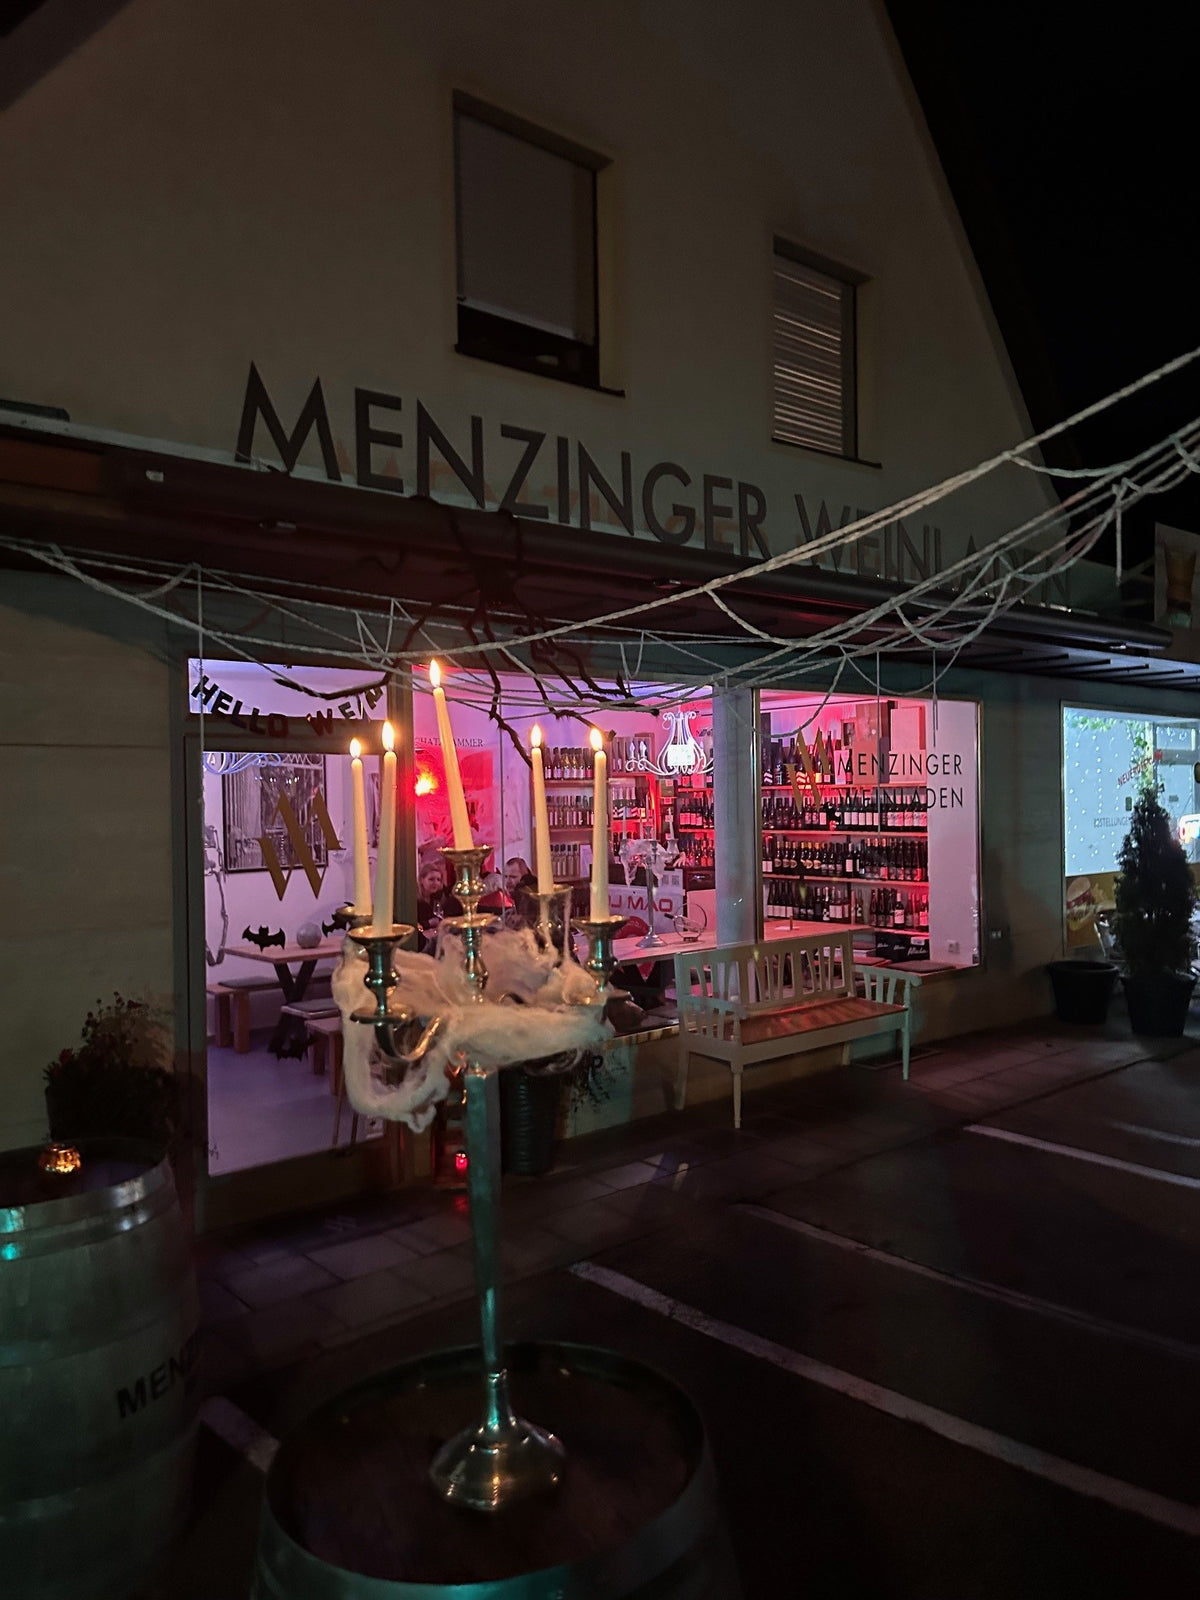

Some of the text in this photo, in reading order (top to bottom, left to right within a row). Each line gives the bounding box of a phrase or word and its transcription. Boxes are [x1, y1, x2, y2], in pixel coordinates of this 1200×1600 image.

[235, 360, 773, 560] MENZINGER
[837, 753, 963, 776] MENZINGER
[838, 787, 964, 809] WEINLADEN
[116, 1346, 190, 1418] MEN
